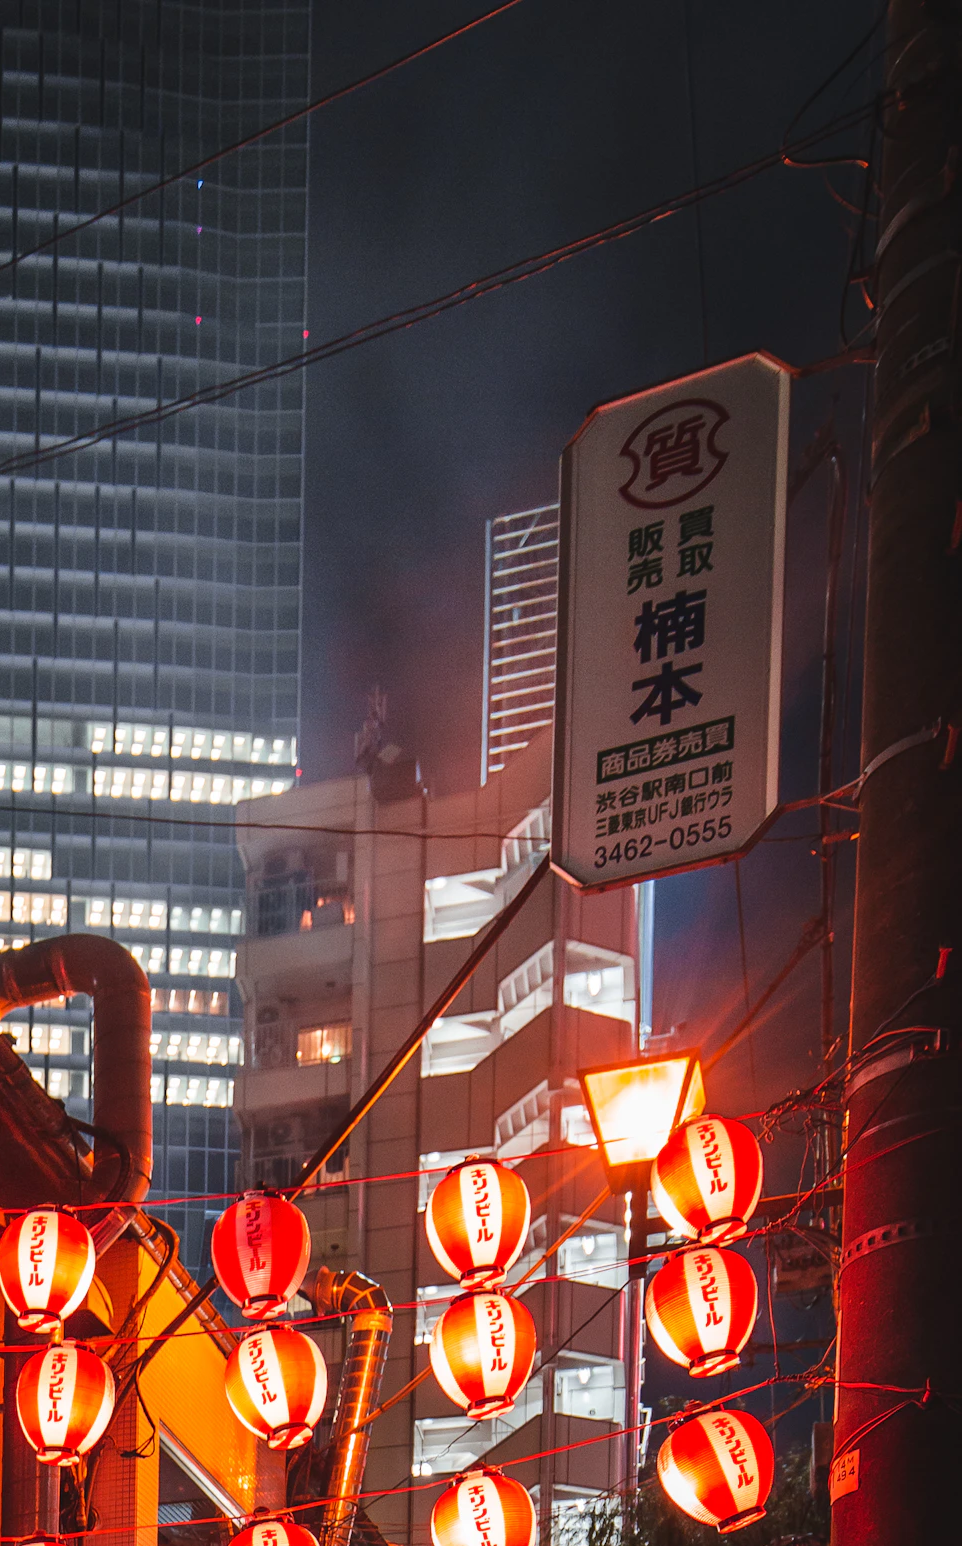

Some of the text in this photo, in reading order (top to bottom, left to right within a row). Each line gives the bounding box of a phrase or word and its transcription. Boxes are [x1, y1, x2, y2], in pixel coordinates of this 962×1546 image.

[644, 414, 705, 492] 質
[627, 520, 665, 595] 販売
[677, 505, 715, 579] 買取
[630, 588, 708, 728] 楠本
[595, 759, 734, 815] 渋谷駅南口前
[601, 722, 730, 780] 商品券売買
[594, 814, 733, 869] 3462-0555
[696, 1121, 729, 1196] キリンビール
[245, 1199, 267, 1272] キリンビール
[470, 1167, 495, 1243] キリンビール
[29, 1215, 47, 1287] キリンビール
[692, 1251, 724, 1328] キリンビール
[247, 1333, 277, 1406] キリンビール
[484, 1299, 508, 1372] キリンビール
[47, 1352, 67, 1423] キリンビール
[712, 1416, 755, 1490] キリンビール
